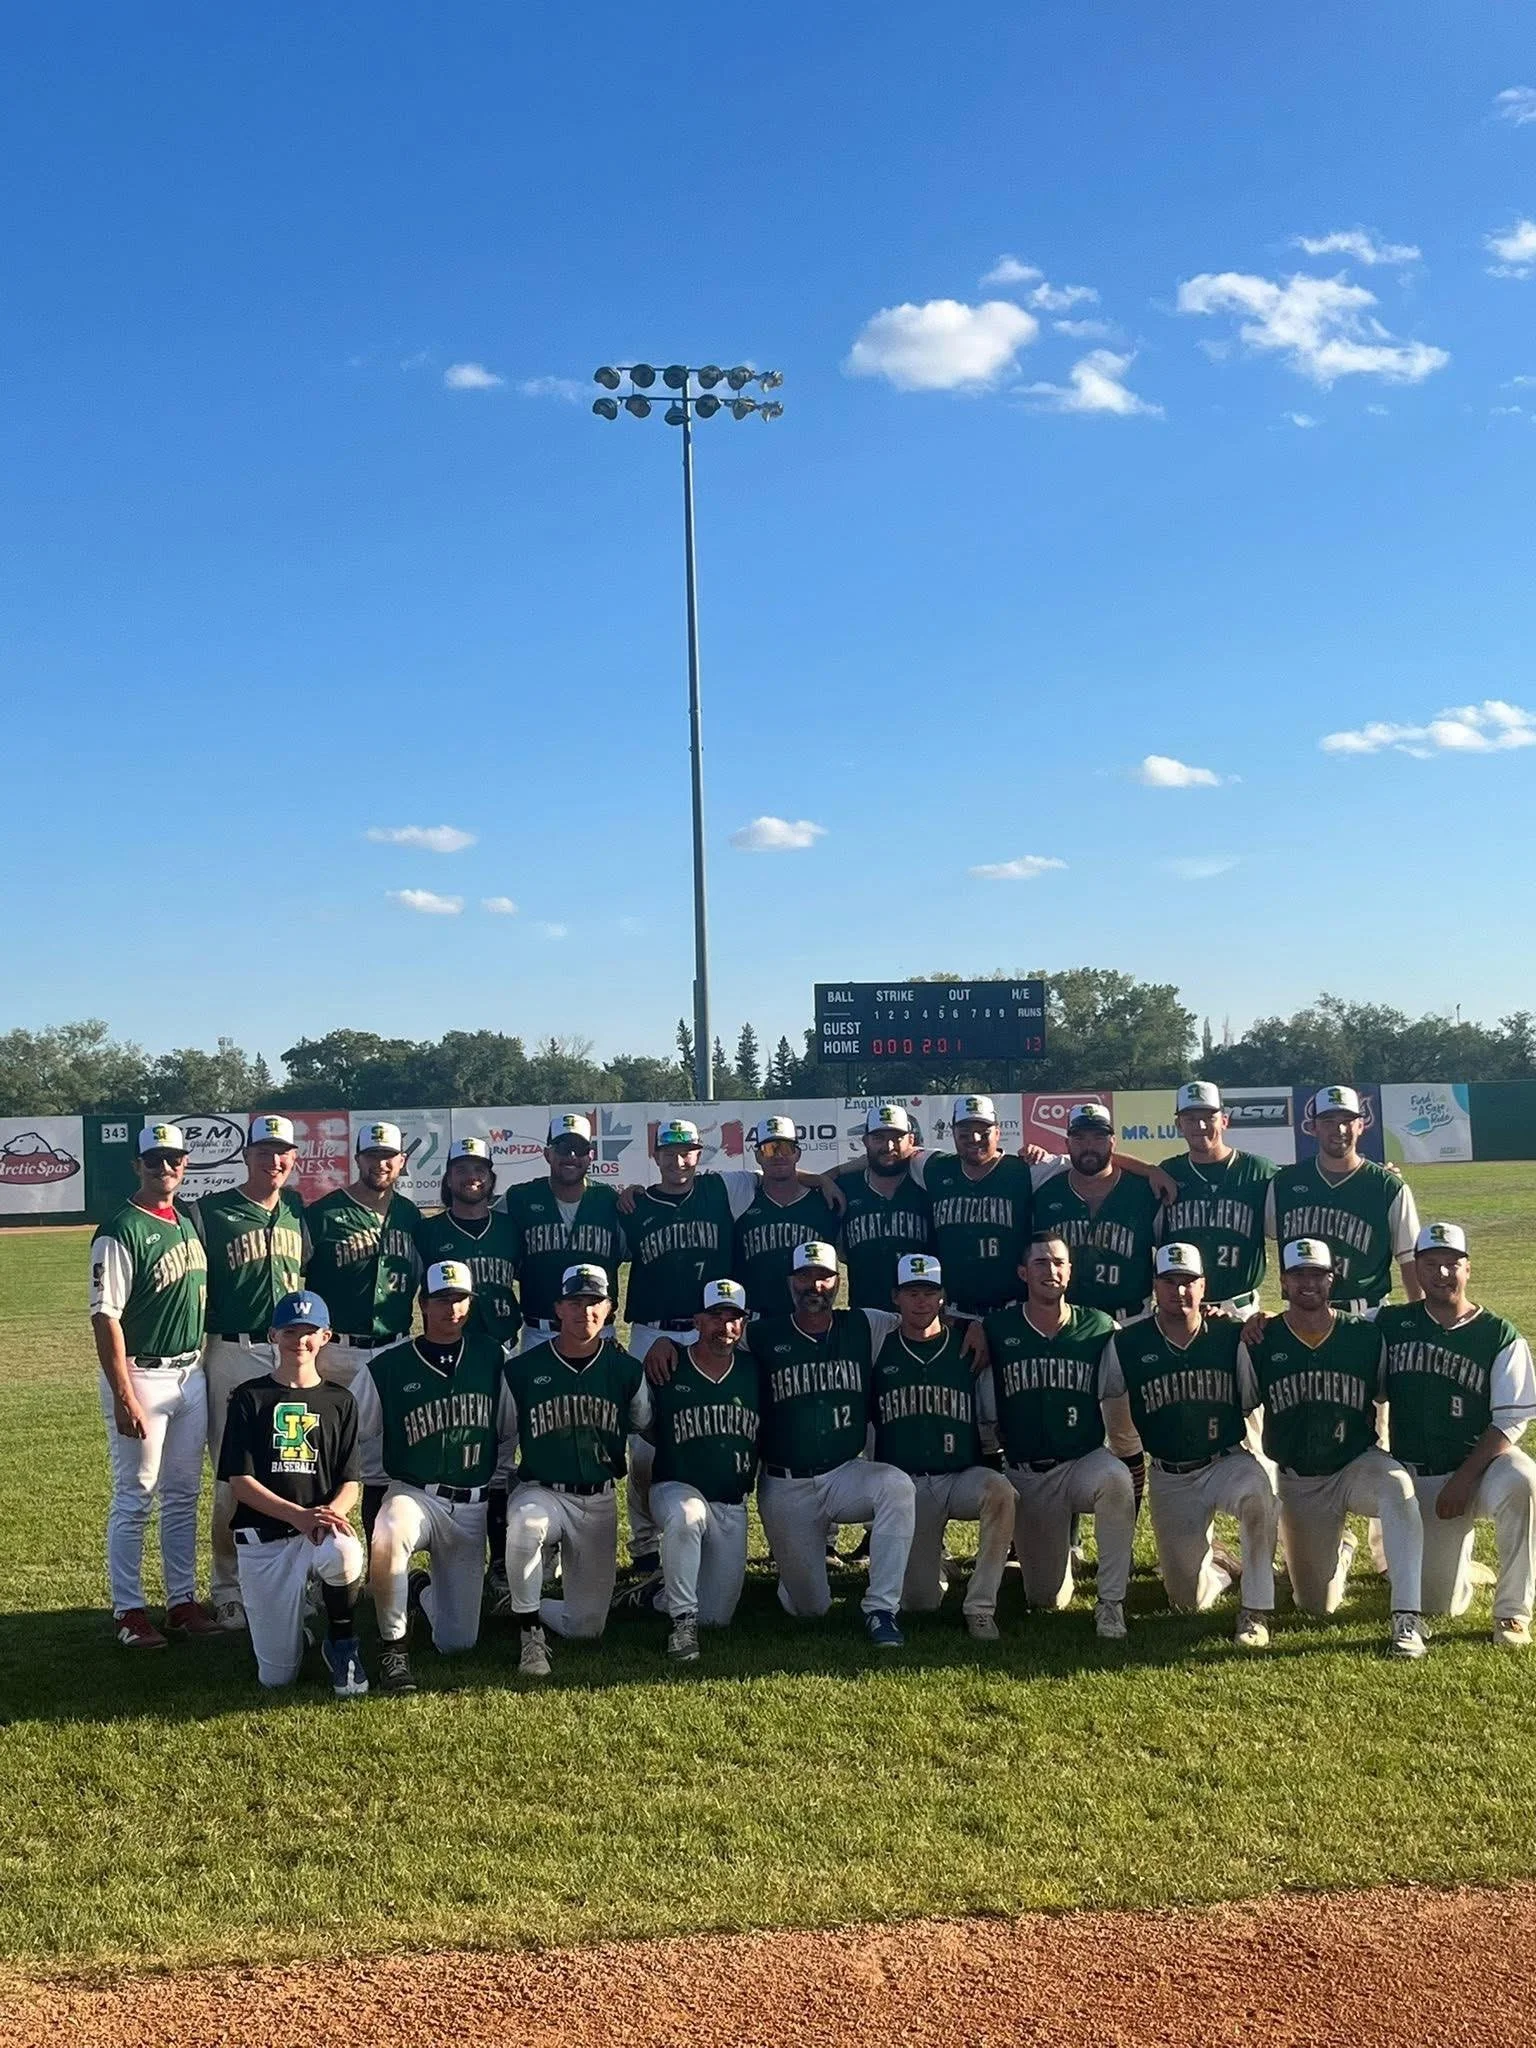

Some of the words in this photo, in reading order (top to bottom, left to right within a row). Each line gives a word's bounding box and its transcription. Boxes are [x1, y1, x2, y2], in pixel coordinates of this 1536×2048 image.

[827, 991, 854, 1003] BALL
[876, 990, 914, 1002] STRIKE
[949, 989, 970, 1001] OUT
[1011, 988, 1030, 1000] H/E
[874, 1010, 880, 1020] 1
[888, 1010, 895, 1020] 2
[903, 1010, 910, 1020] 3
[922, 1009, 928, 1019] 4
[953, 1009, 959, 1019] 6
[971, 1008, 977, 1018] 7
[985, 1008, 991, 1018] 8
[1018, 1007, 1042, 1018] RUNS
[823, 1022, 861, 1035] GUEST
[823, 1041, 860, 1054] HOME
[104, 1127, 127, 1140] 343
[181, 1125, 233, 1140] BM
[745, 1124, 837, 1142] ADIO
[1121, 1125, 1155, 1140] MR.
[37, 1161, 71, 1176] Spas
[978, 1237, 999, 1258] 16
[693, 1261, 705, 1281] 7
[1095, 1264, 1120, 1286] 20
[292, 1302, 312, 1315] W
[404, 1392, 493, 1447] SASKATCHEWA
[530, 1394, 620, 1439] SASKATCHEWA
[833, 1405, 851, 1430] 12
[1066, 1406, 1078, 1427] 3
[1333, 1419, 1346, 1444] 4
[271, 1461, 317, 1474] BASEBALL
